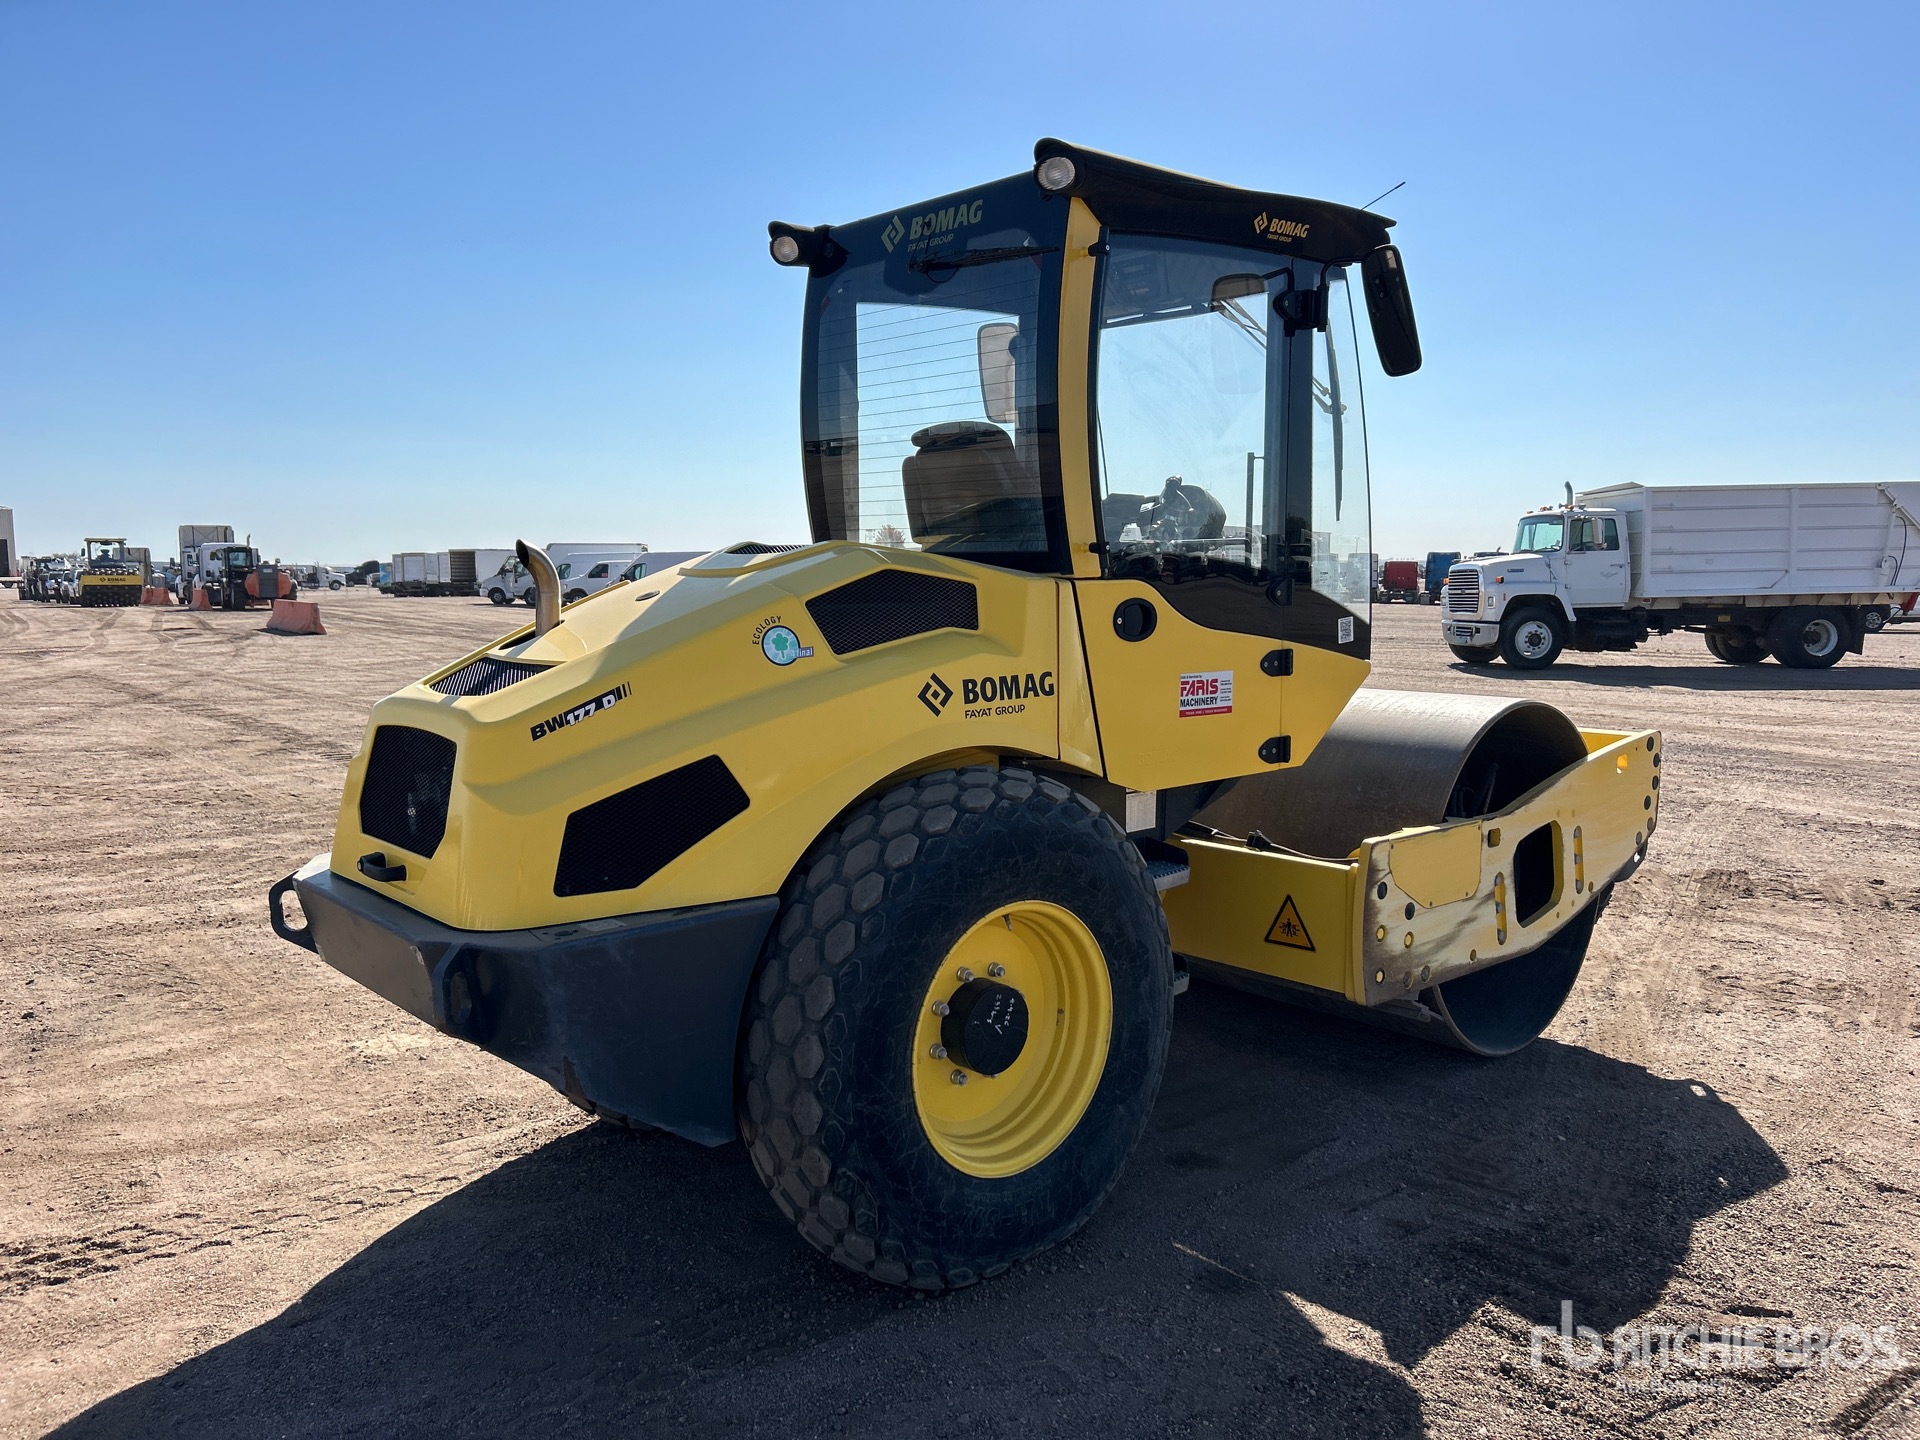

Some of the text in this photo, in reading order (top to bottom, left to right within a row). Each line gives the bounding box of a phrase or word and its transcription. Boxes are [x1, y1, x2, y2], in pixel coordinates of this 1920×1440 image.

[909, 199, 983, 240] BOMAG
[1269, 218, 1310, 238] BOMAG
[929, 233, 954, 247] GROUP
[752, 615, 782, 645] ECOLOGY
[962, 671, 1055, 705] BOMAG
[1180, 678, 1219, 697] FARIS
[964, 704, 1026, 719] FAYAT GROUP
[1180, 696, 1219, 708] MACHINERY
